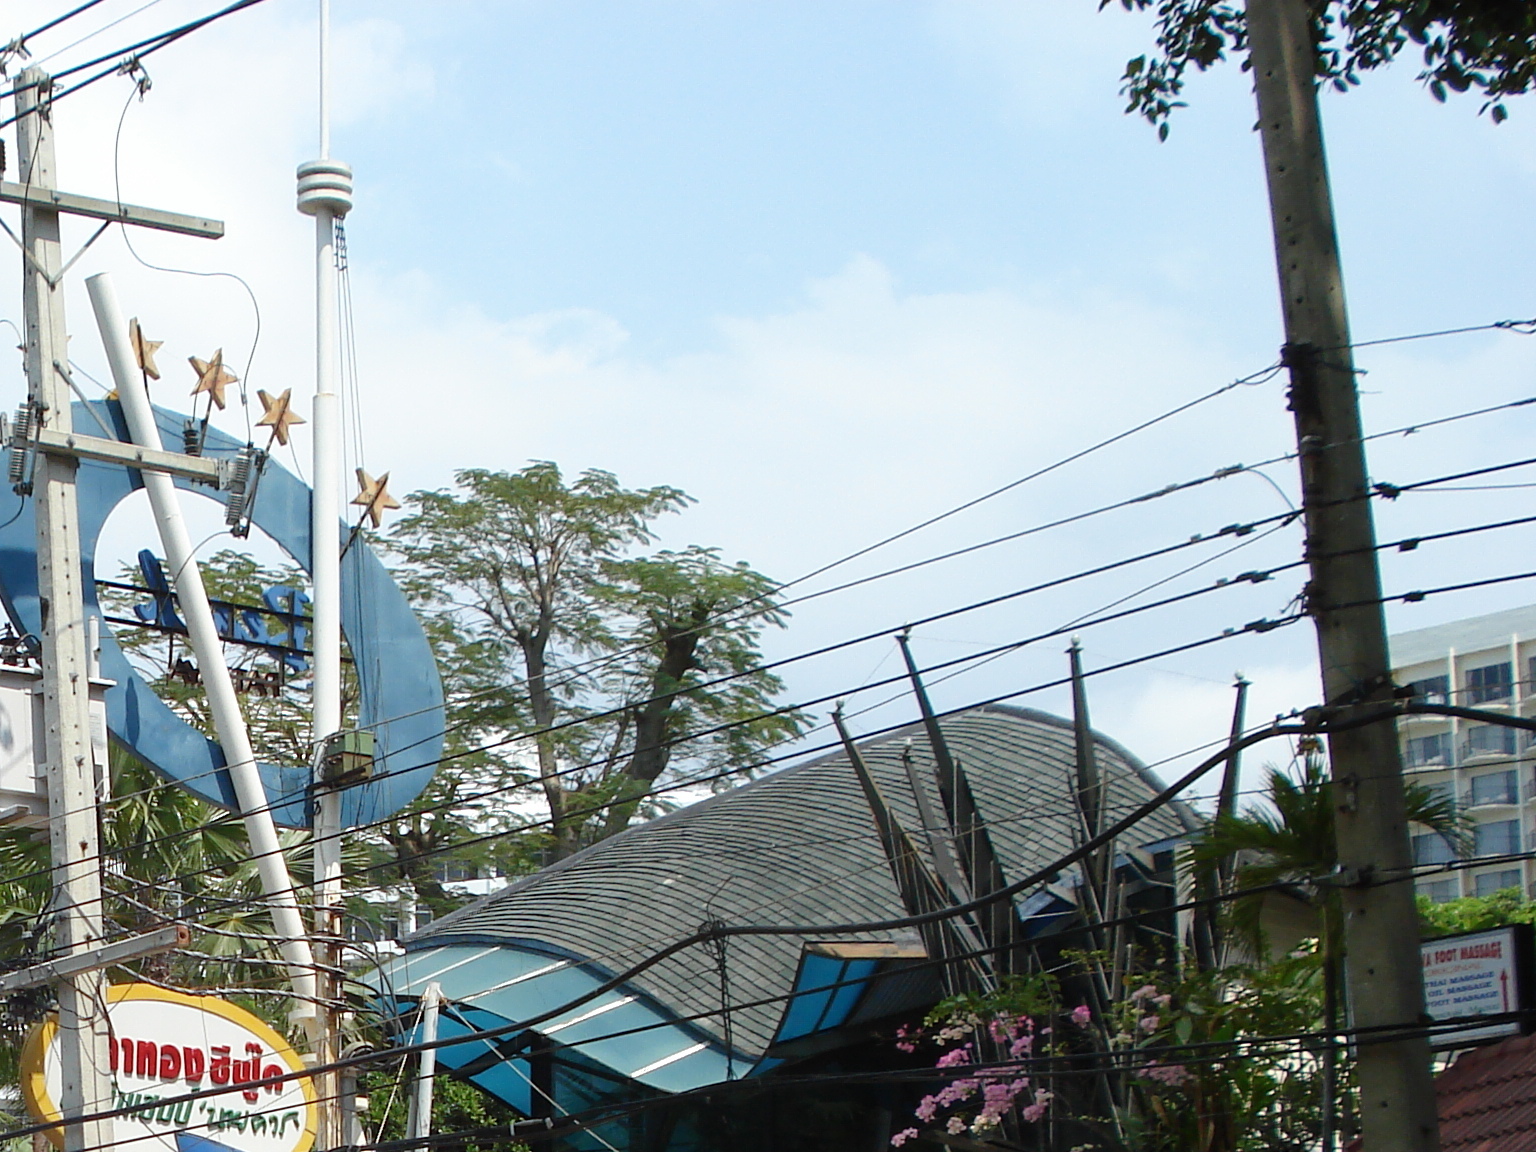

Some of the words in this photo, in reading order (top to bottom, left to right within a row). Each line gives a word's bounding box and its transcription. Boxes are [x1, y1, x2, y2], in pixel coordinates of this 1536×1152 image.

[1434, 948, 1457, 963] FOOT
[1460, 941, 1502, 959] MASSAGE
[1450, 971, 1495, 983] MASSAGE
[1447, 981, 1492, 994] MASSAGE
[1453, 991, 1498, 1003] MASSAGE
